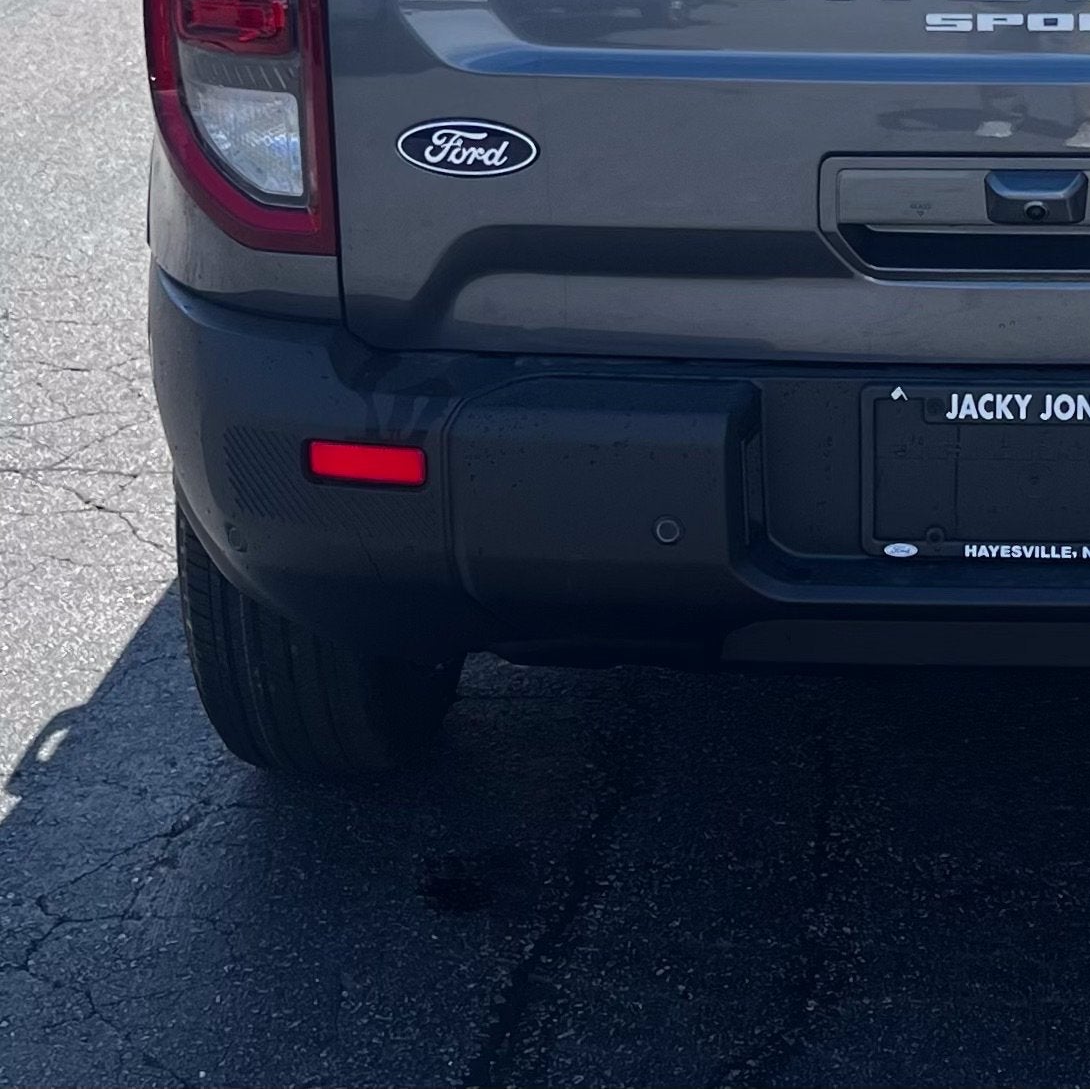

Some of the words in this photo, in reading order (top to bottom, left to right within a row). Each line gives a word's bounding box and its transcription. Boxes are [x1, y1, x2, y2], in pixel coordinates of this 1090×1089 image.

[424, 128, 510, 167] Ford
[945, 393, 1033, 421] JACKY
[964, 544, 1078, 559] HAYESVILLE,
